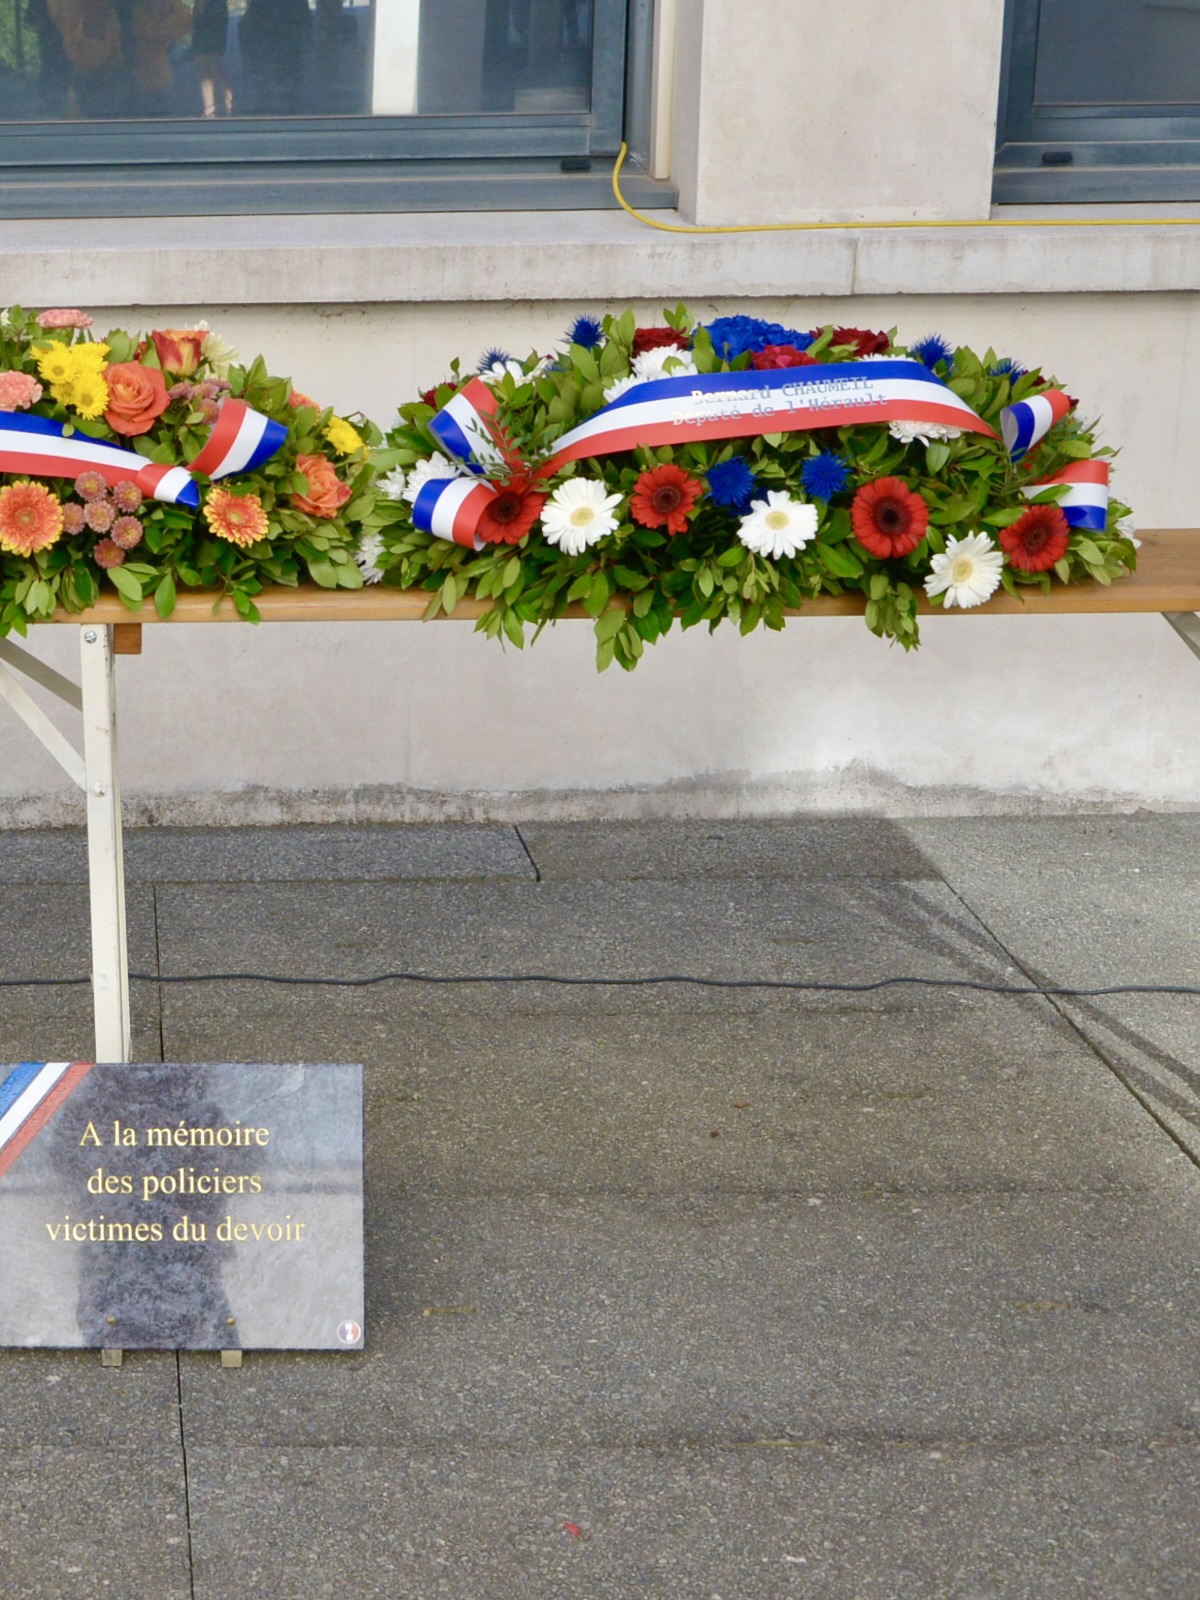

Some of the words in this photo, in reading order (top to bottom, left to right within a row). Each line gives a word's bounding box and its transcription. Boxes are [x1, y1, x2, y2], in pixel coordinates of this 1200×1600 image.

[691, 384, 771, 405] Bernard
[782, 376, 873, 397] CHAUMEIL
[672, 405, 742, 426] Député
[752, 403, 775, 418] de
[785, 393, 889, 414] l'Hérault
[79, 1121, 103, 1146] A
[113, 1121, 138, 1146] la
[146, 1120, 270, 1146] mémoire
[86, 1169, 133, 1194] des
[142, 1168, 262, 1201] policiers
[45, 1216, 163, 1242] victimes
[172, 1216, 207, 1242] du
[215, 1216, 306, 1242] devoir
